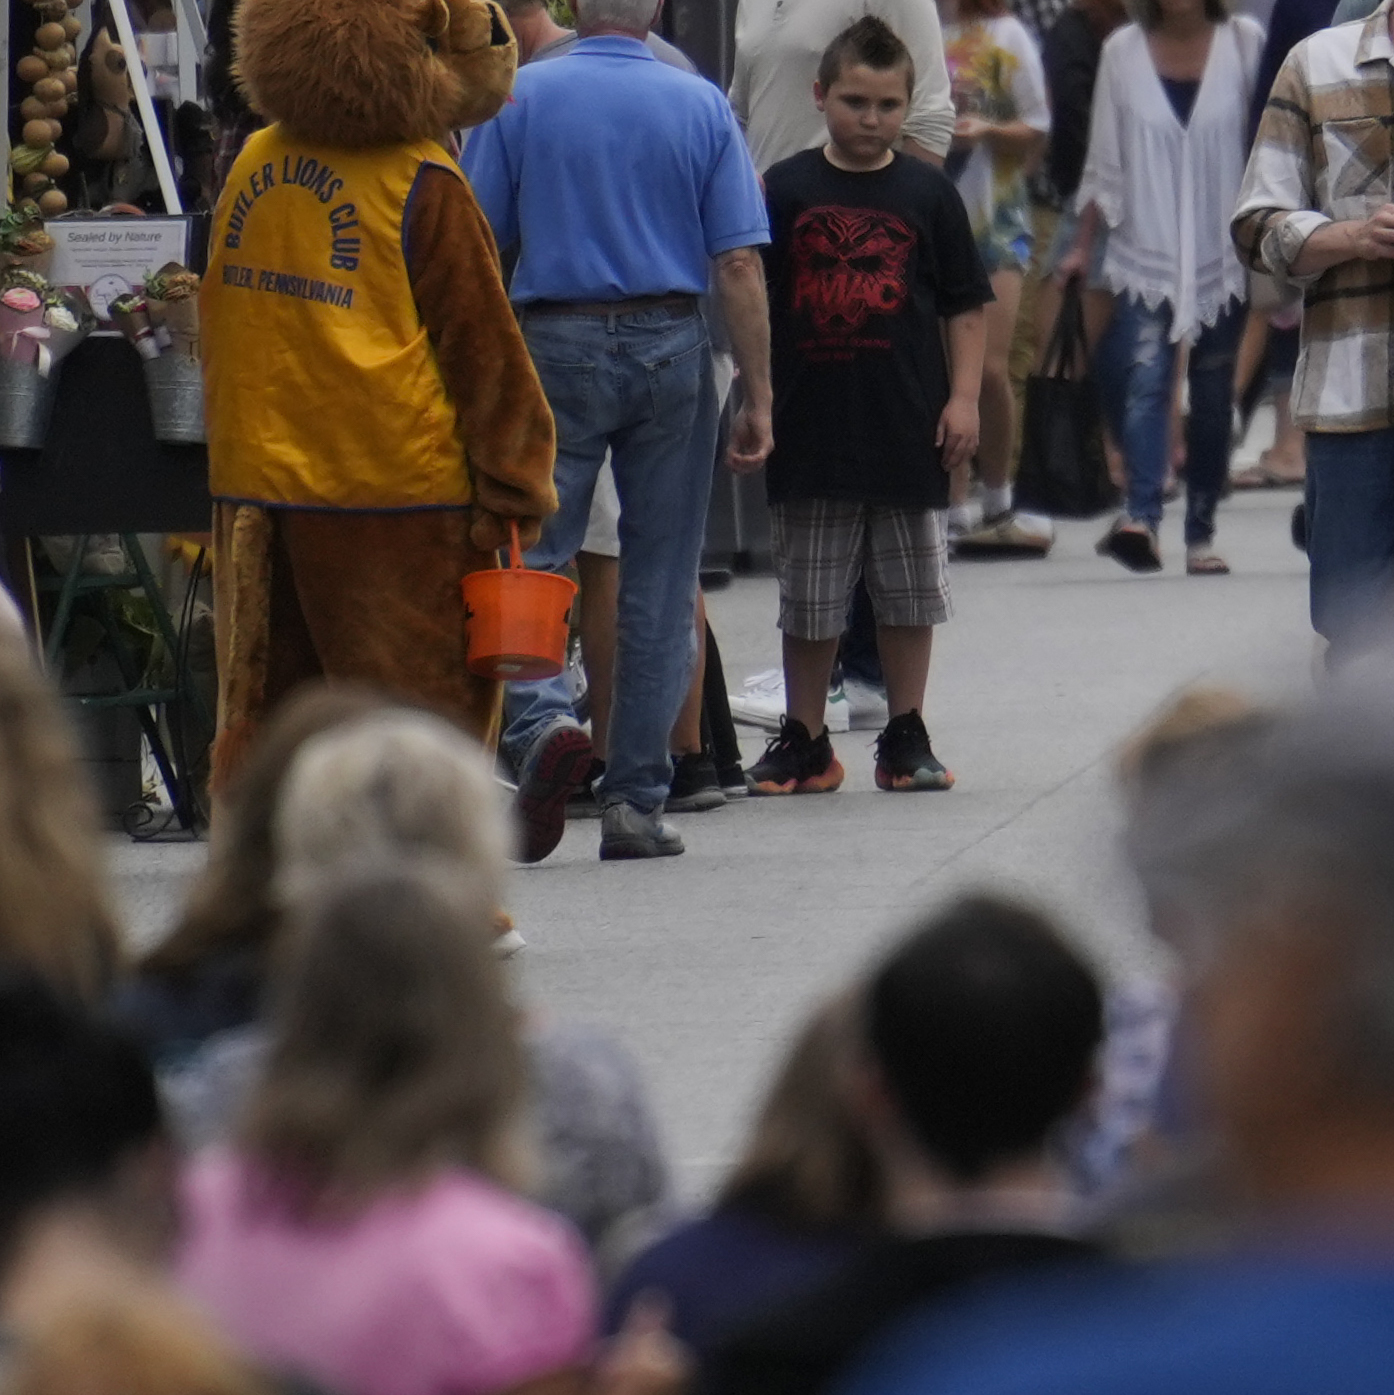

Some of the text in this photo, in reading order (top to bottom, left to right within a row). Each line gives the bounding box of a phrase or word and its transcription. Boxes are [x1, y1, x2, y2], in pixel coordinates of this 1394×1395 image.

[67, 231, 163, 245] Sealed by Nature
[225, 155, 361, 272] BUTLER LIONS CLUB
